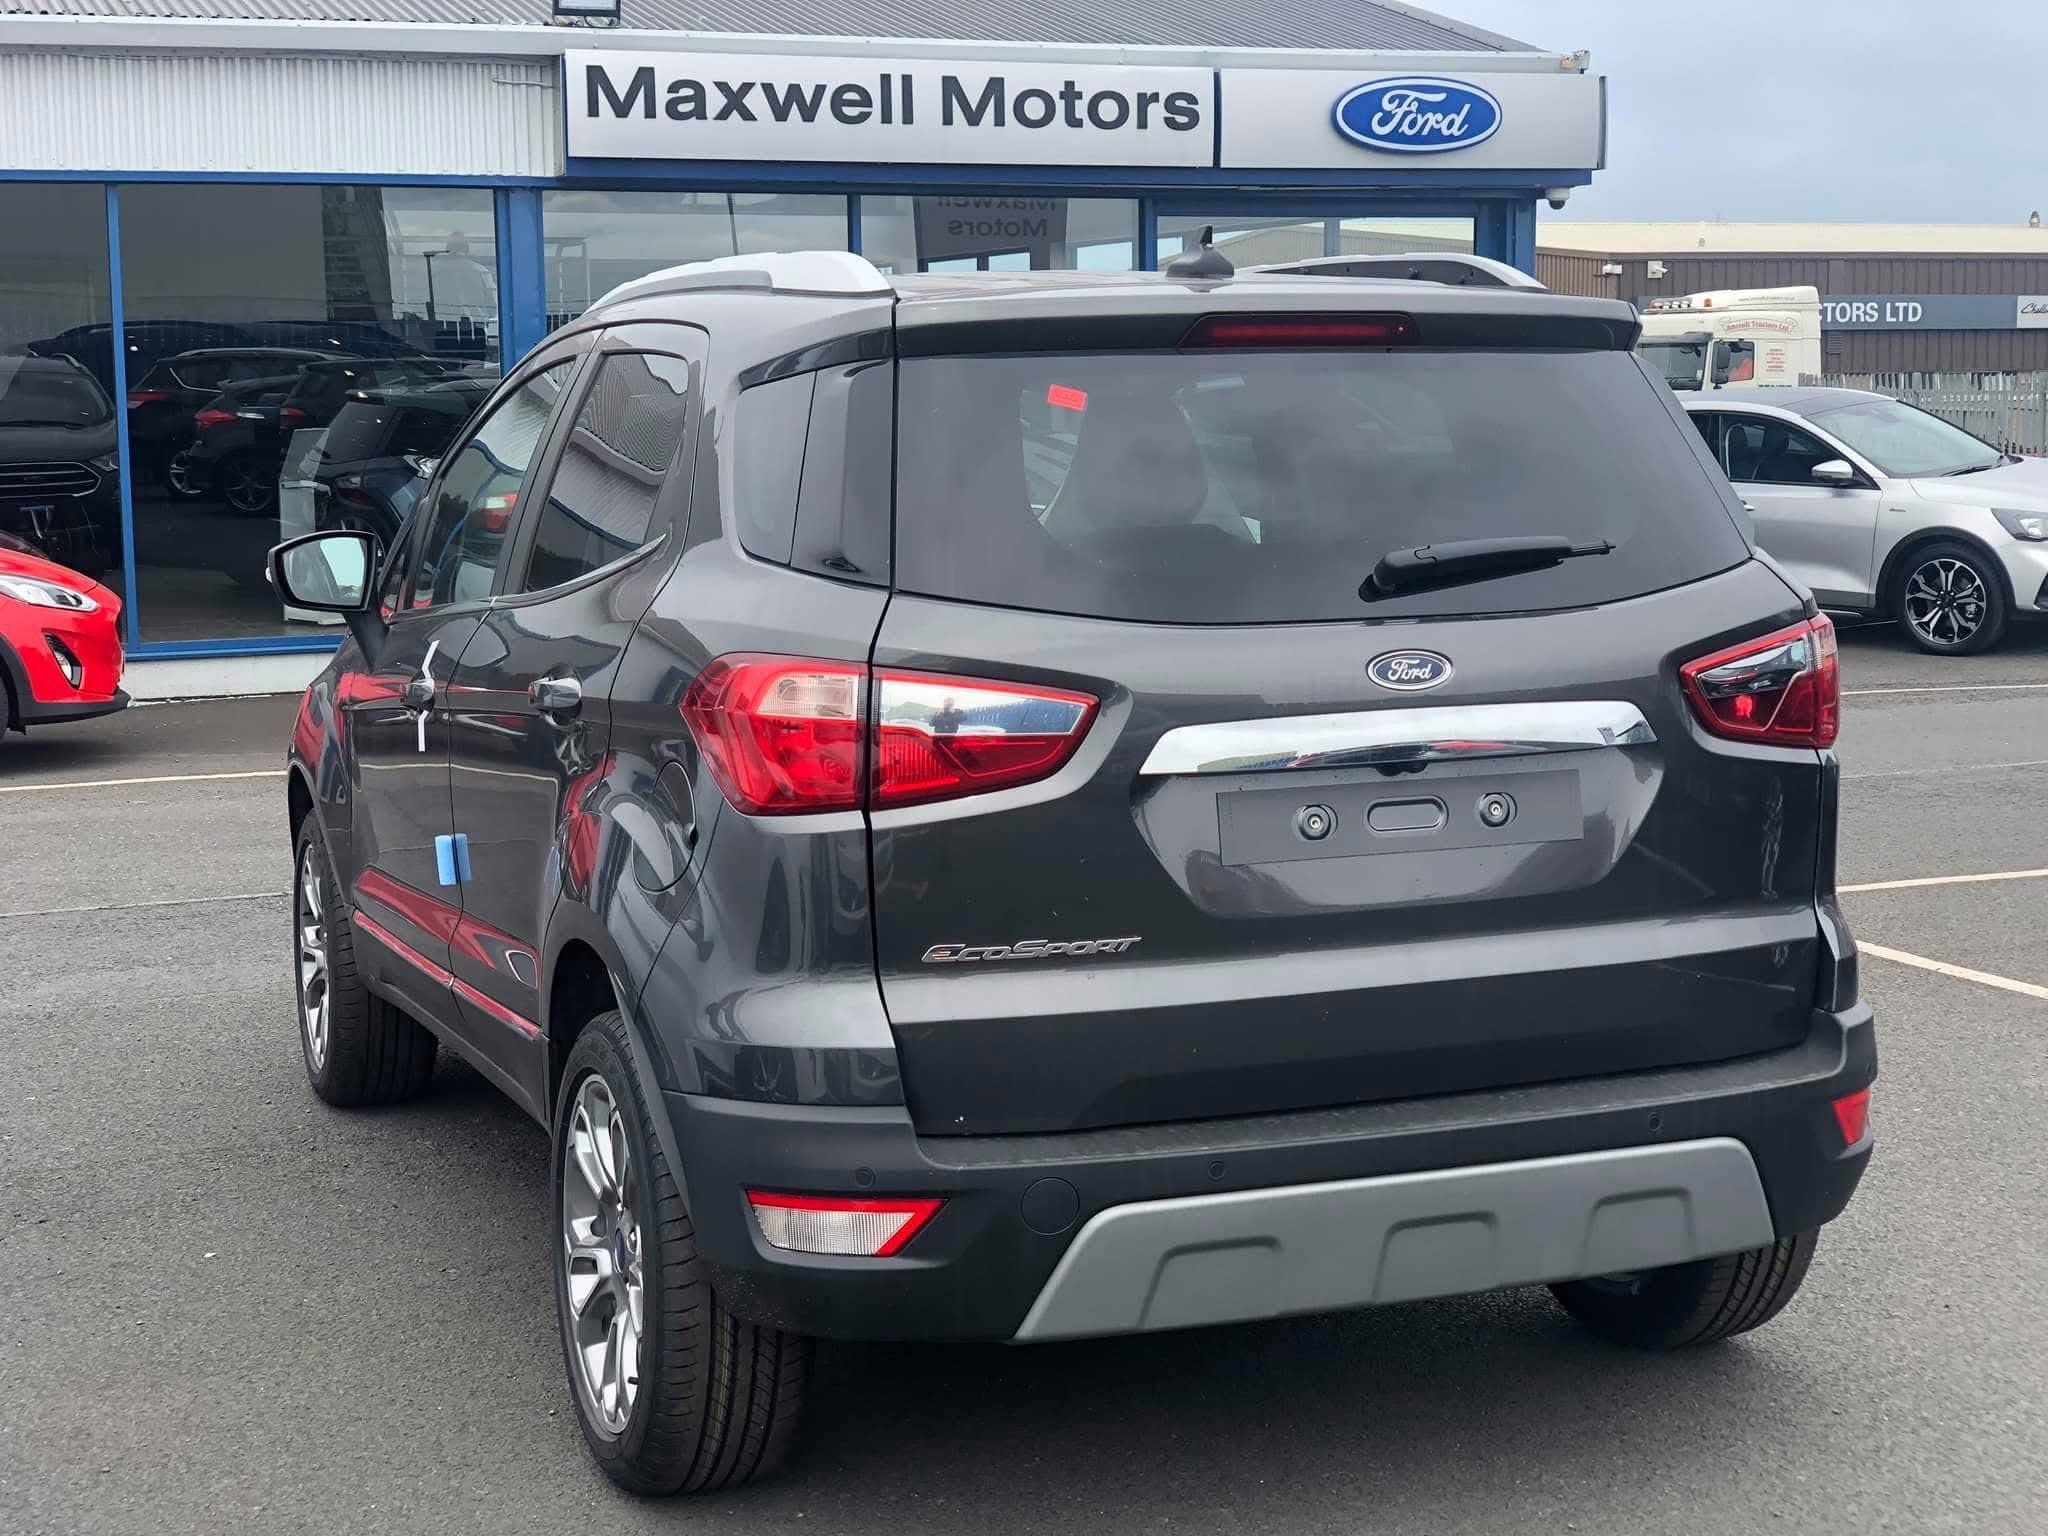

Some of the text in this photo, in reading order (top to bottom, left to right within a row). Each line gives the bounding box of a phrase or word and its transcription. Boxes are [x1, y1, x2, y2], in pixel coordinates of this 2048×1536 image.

[586, 64, 1201, 132] Maxwell Motors
[1371, 89, 1471, 137] Ford
[1817, 301, 1923, 323] TORS LTD
[1387, 658, 1433, 681] Ford
